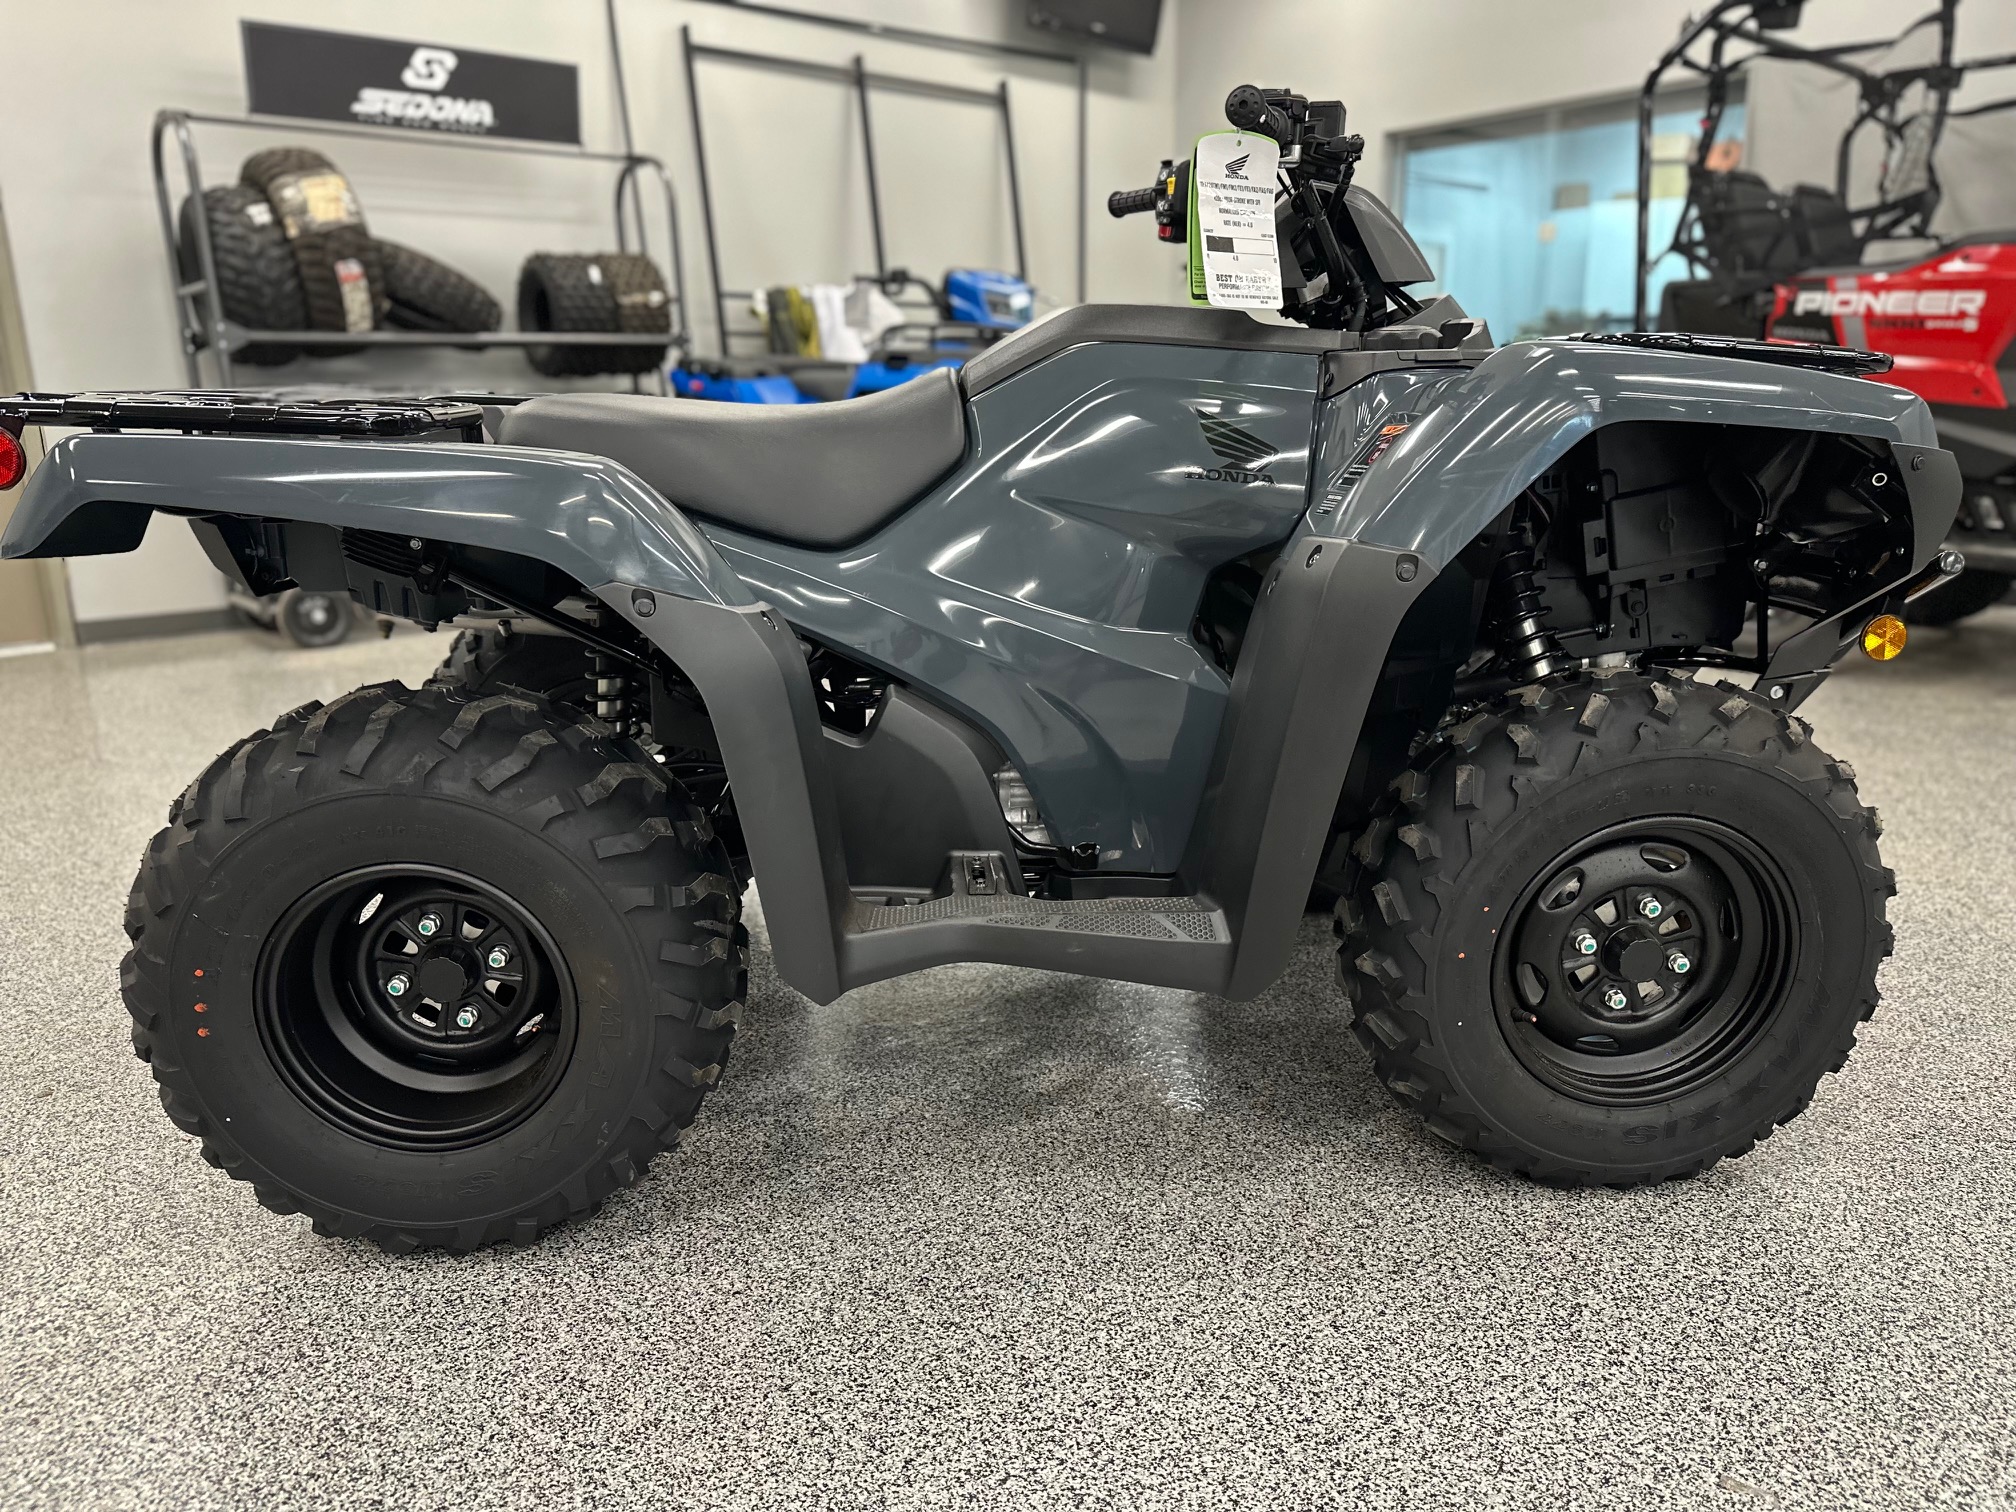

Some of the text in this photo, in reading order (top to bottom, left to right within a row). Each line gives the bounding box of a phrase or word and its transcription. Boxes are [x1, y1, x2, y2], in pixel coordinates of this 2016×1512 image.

[350, 87, 494, 127] SEDONA
[1216, 274, 1233, 282] BEST
[1793, 290, 1987, 316] PIONEER
[1184, 466, 1277, 487] HONDA
[1622, 975, 1832, 1146] MAXXIS
[456, 984, 624, 1197] MAXXIS
